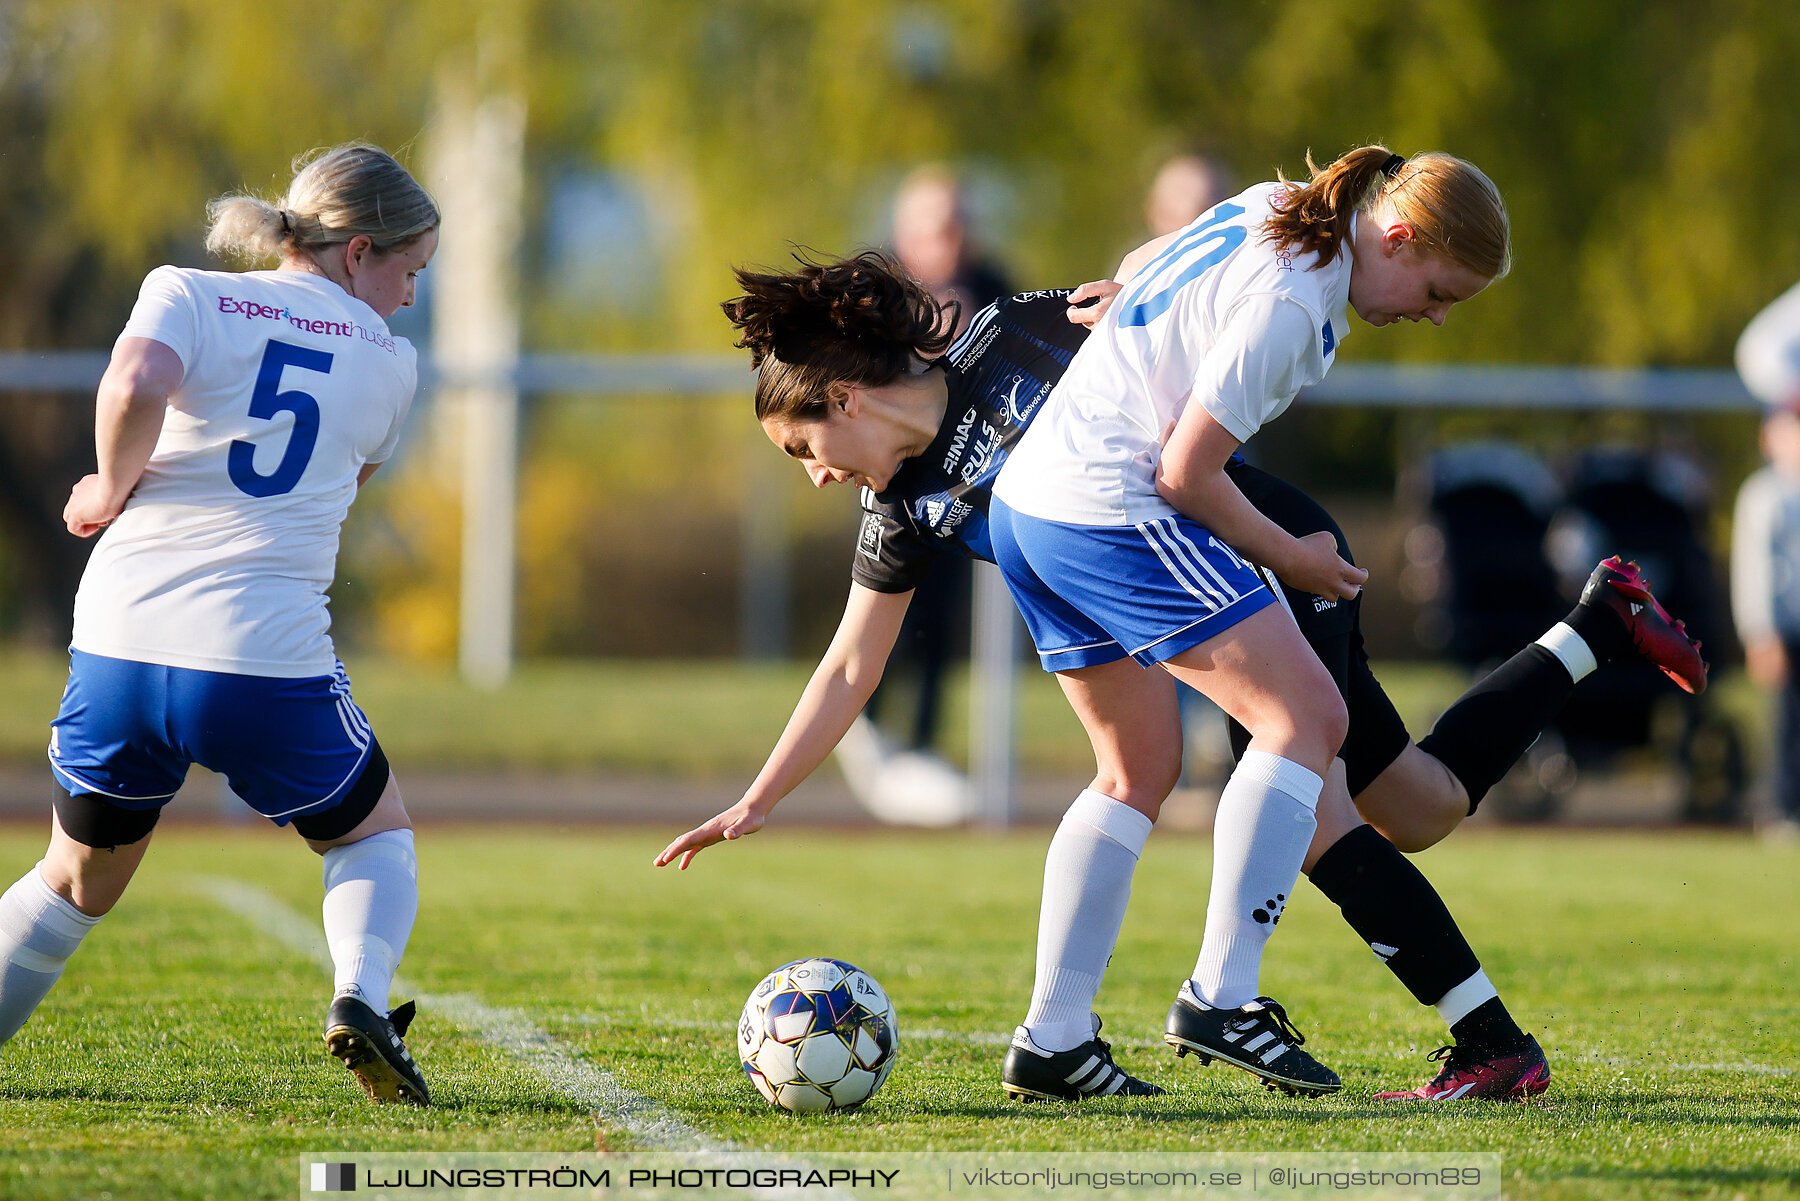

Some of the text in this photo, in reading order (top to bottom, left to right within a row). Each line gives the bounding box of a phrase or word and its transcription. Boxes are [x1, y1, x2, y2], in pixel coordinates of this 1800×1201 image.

[1118, 203, 1247, 328] 10
[218, 296, 397, 356] Experimenthuset
[227, 339, 335, 498] 5
[961, 420, 996, 481] PULS
[944, 498, 965, 527] INTER
[953, 503, 974, 526] SPORT
